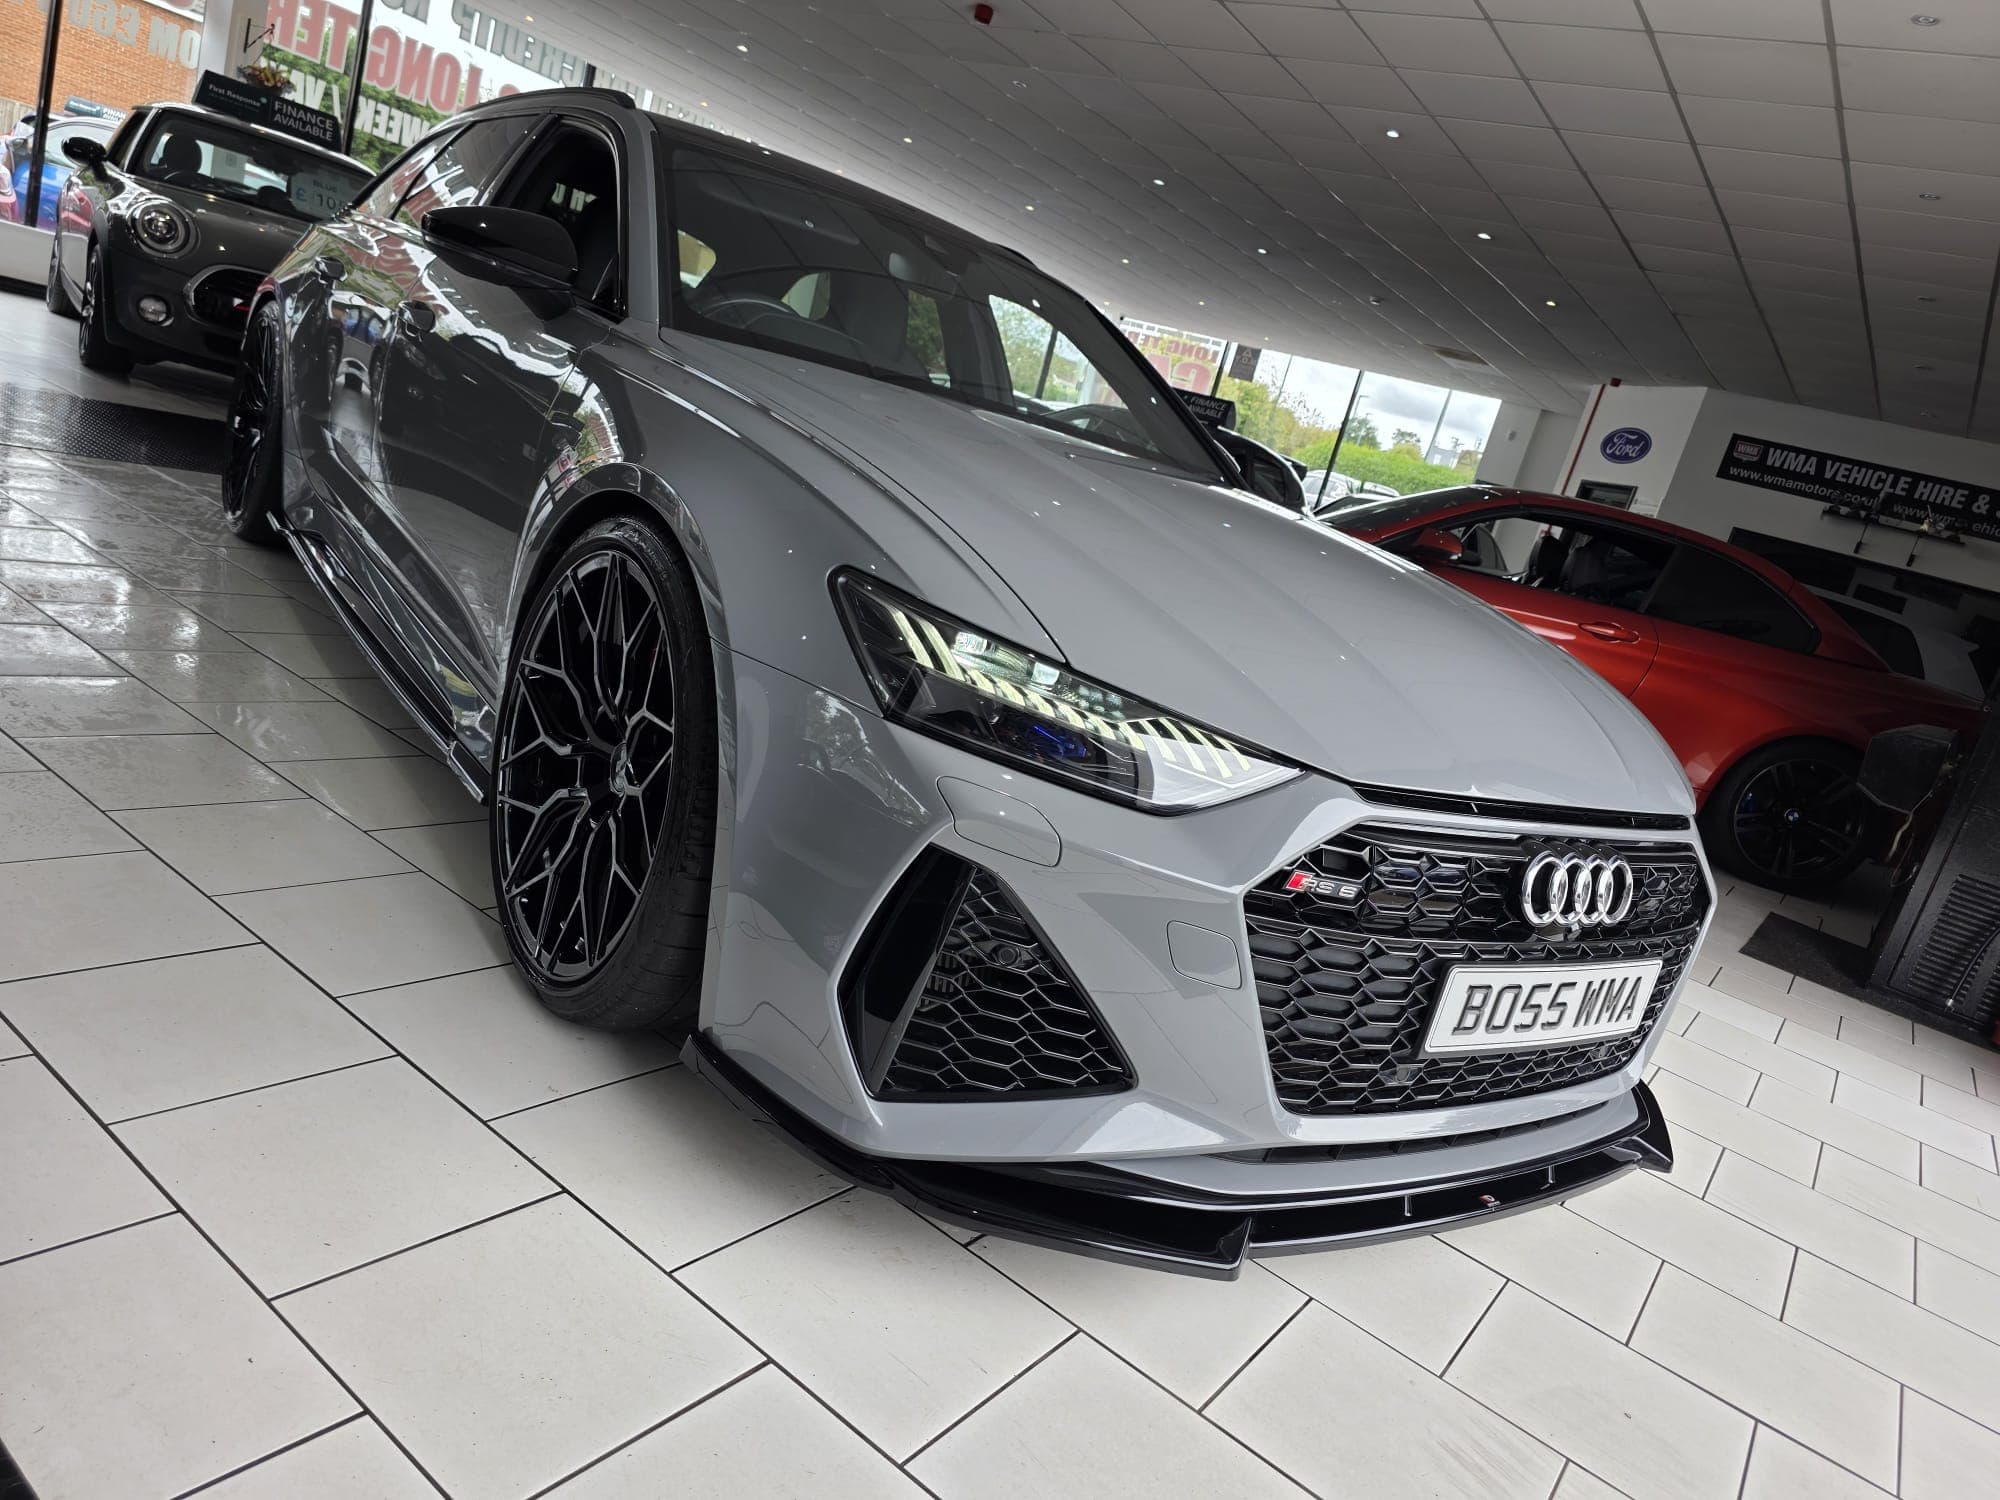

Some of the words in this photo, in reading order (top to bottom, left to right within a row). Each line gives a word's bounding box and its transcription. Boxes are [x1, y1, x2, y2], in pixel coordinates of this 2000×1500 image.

[273, 101, 334, 131] FINANCE
[273, 113, 333, 141] AVAILABLE
[1190, 396, 1226, 411] FINANCE
[1766, 447, 1818, 476] WMA
[1824, 460, 1912, 496] VEHICLE
[1914, 477, 1969, 509] HIRE
[1972, 494, 1991, 514] &
[1573, 976, 1643, 1028] WMA
